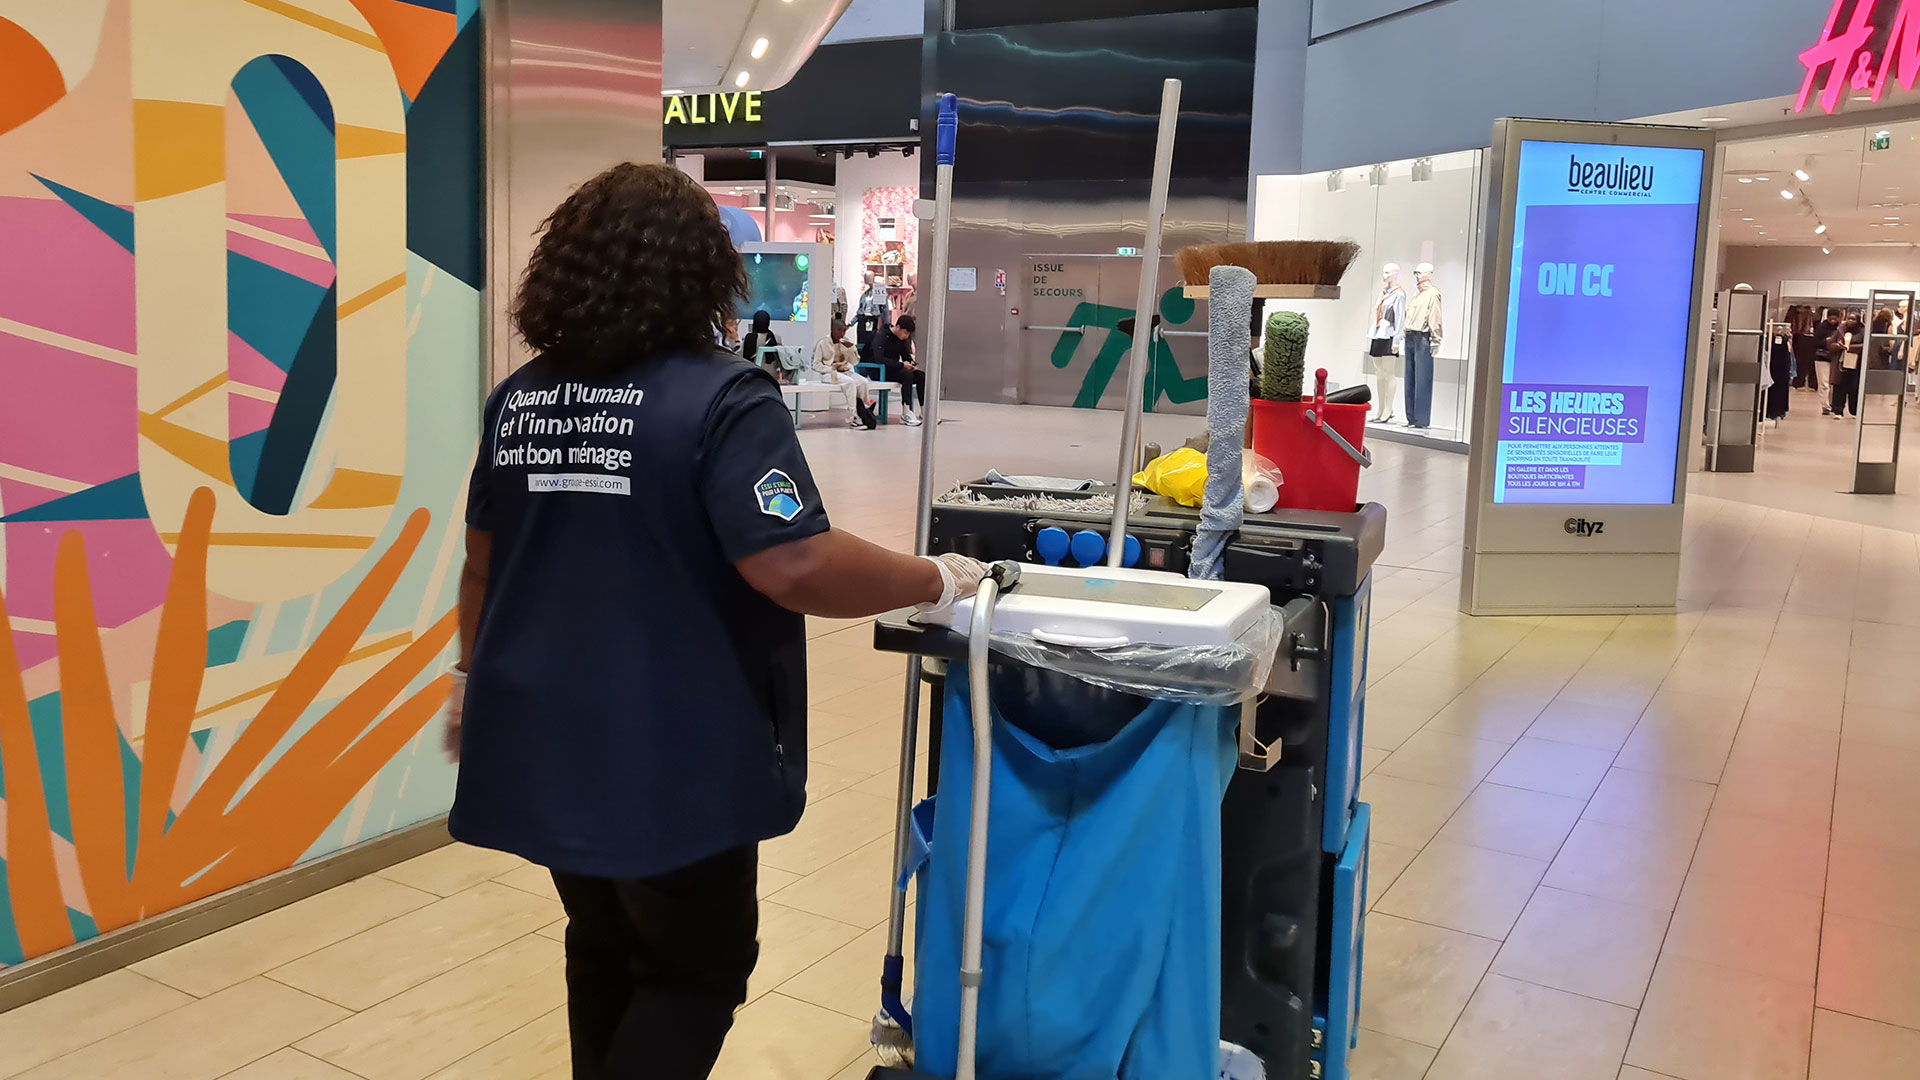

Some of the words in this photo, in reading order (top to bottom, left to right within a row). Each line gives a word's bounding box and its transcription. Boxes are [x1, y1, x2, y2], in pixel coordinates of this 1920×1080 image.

[664, 91, 762, 124] ALIVE
[1568, 154, 1654, 191] beaulieu
[1033, 263, 1064, 272] ISSUE
[1033, 276, 1047, 284] DE
[1538, 262, 1577, 296] ON
[1033, 288, 1083, 297] SECOURS
[508, 384, 561, 411] Quand
[1510, 391, 1547, 413] LES
[1549, 391, 1625, 415] HEURES
[501, 417, 515, 437] et
[1508, 416, 1639, 436] SILENCIEUSES
[526, 442, 562, 465] bon
[568, 441, 632, 471] ménage
[1564, 518, 1604, 536] Cityz
